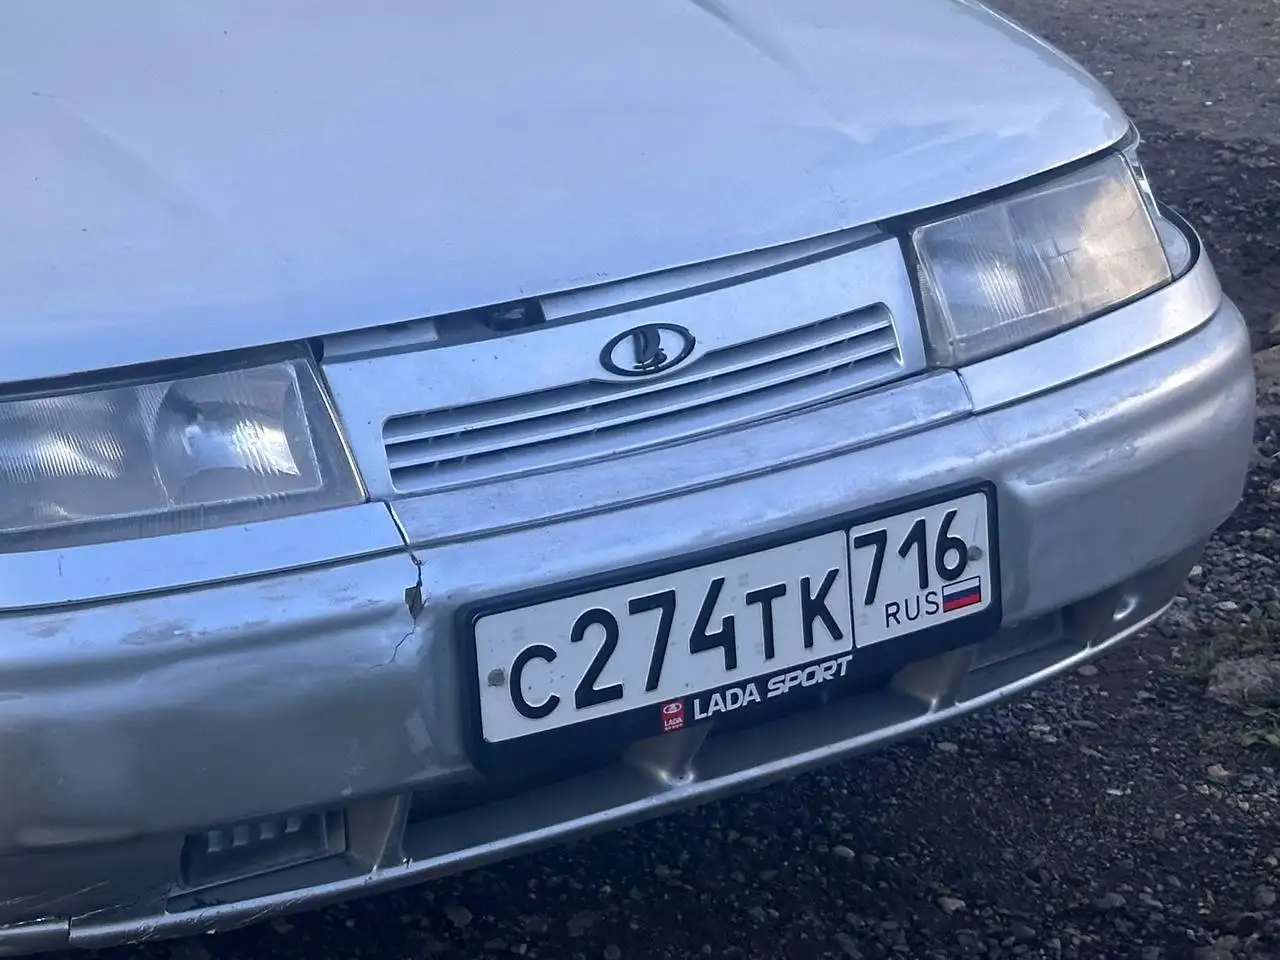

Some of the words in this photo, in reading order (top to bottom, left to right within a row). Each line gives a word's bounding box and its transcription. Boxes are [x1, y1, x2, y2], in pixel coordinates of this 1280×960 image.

[510, 568, 844, 720] C274TK
[854, 509, 968, 606] 716
[885, 591, 940, 628] RUS
[694, 683, 761, 720] LADA
[767, 655, 853, 698] SPORT
